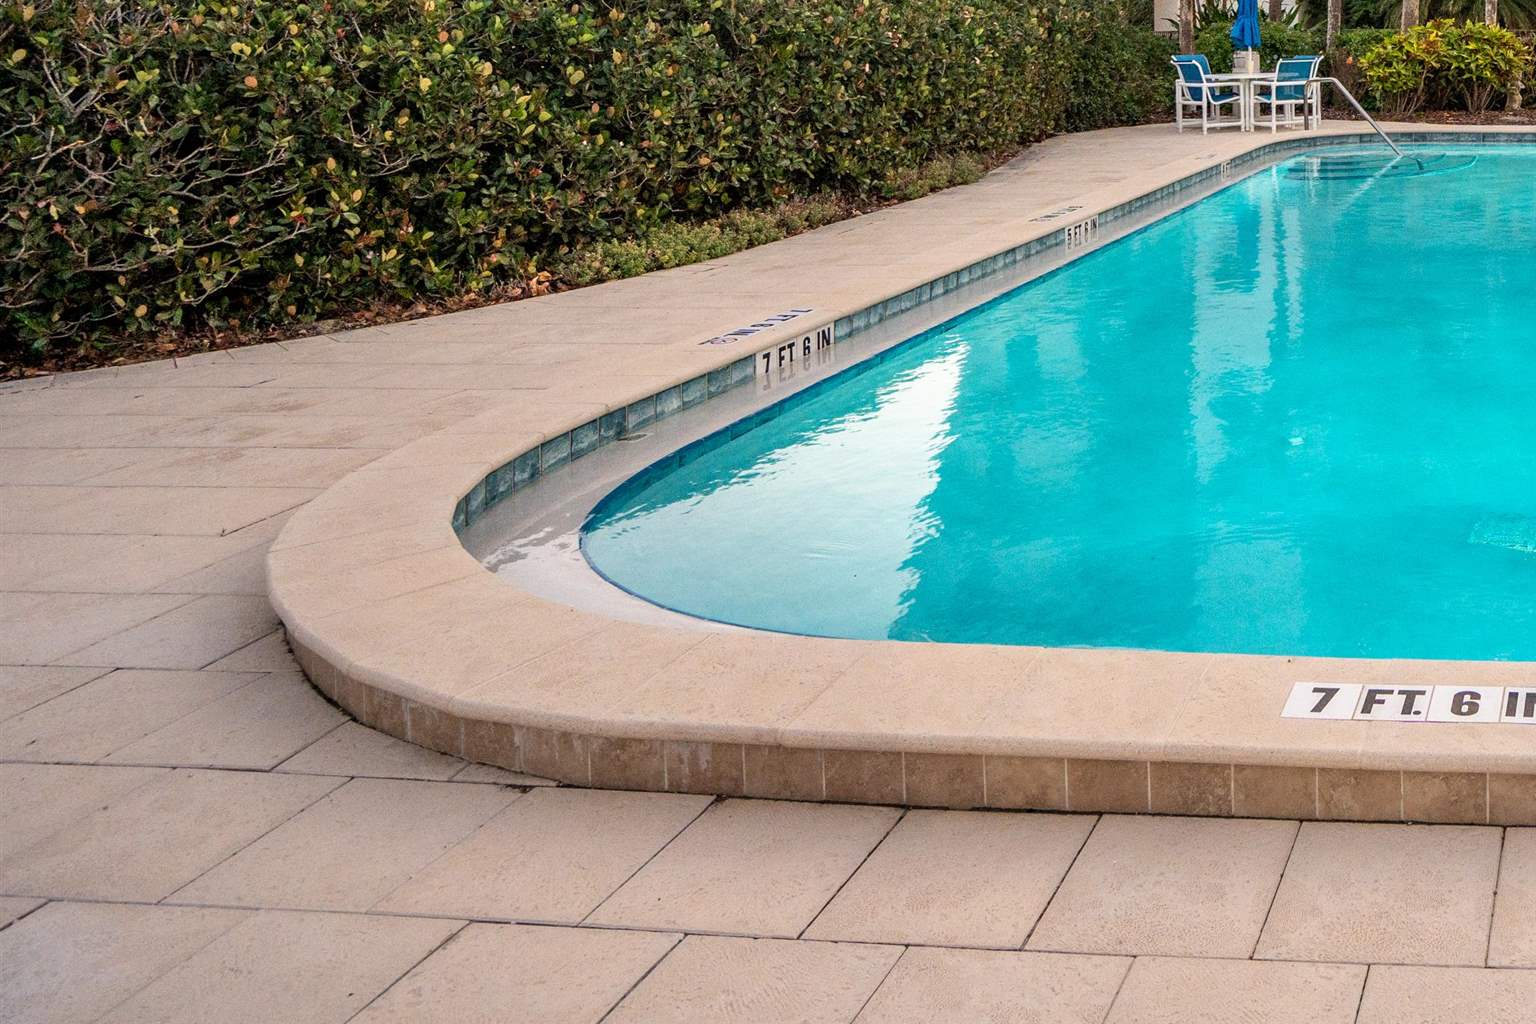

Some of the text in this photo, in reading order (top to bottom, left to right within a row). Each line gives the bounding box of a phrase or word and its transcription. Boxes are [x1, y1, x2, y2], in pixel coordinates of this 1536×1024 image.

[1074, 224, 1082, 238] FT
[762, 327, 831, 374] 7 FT 6 IN
[1311, 687, 1340, 713] 7
[1360, 689, 1427, 716] FT.
[1450, 690, 1482, 717] 6
